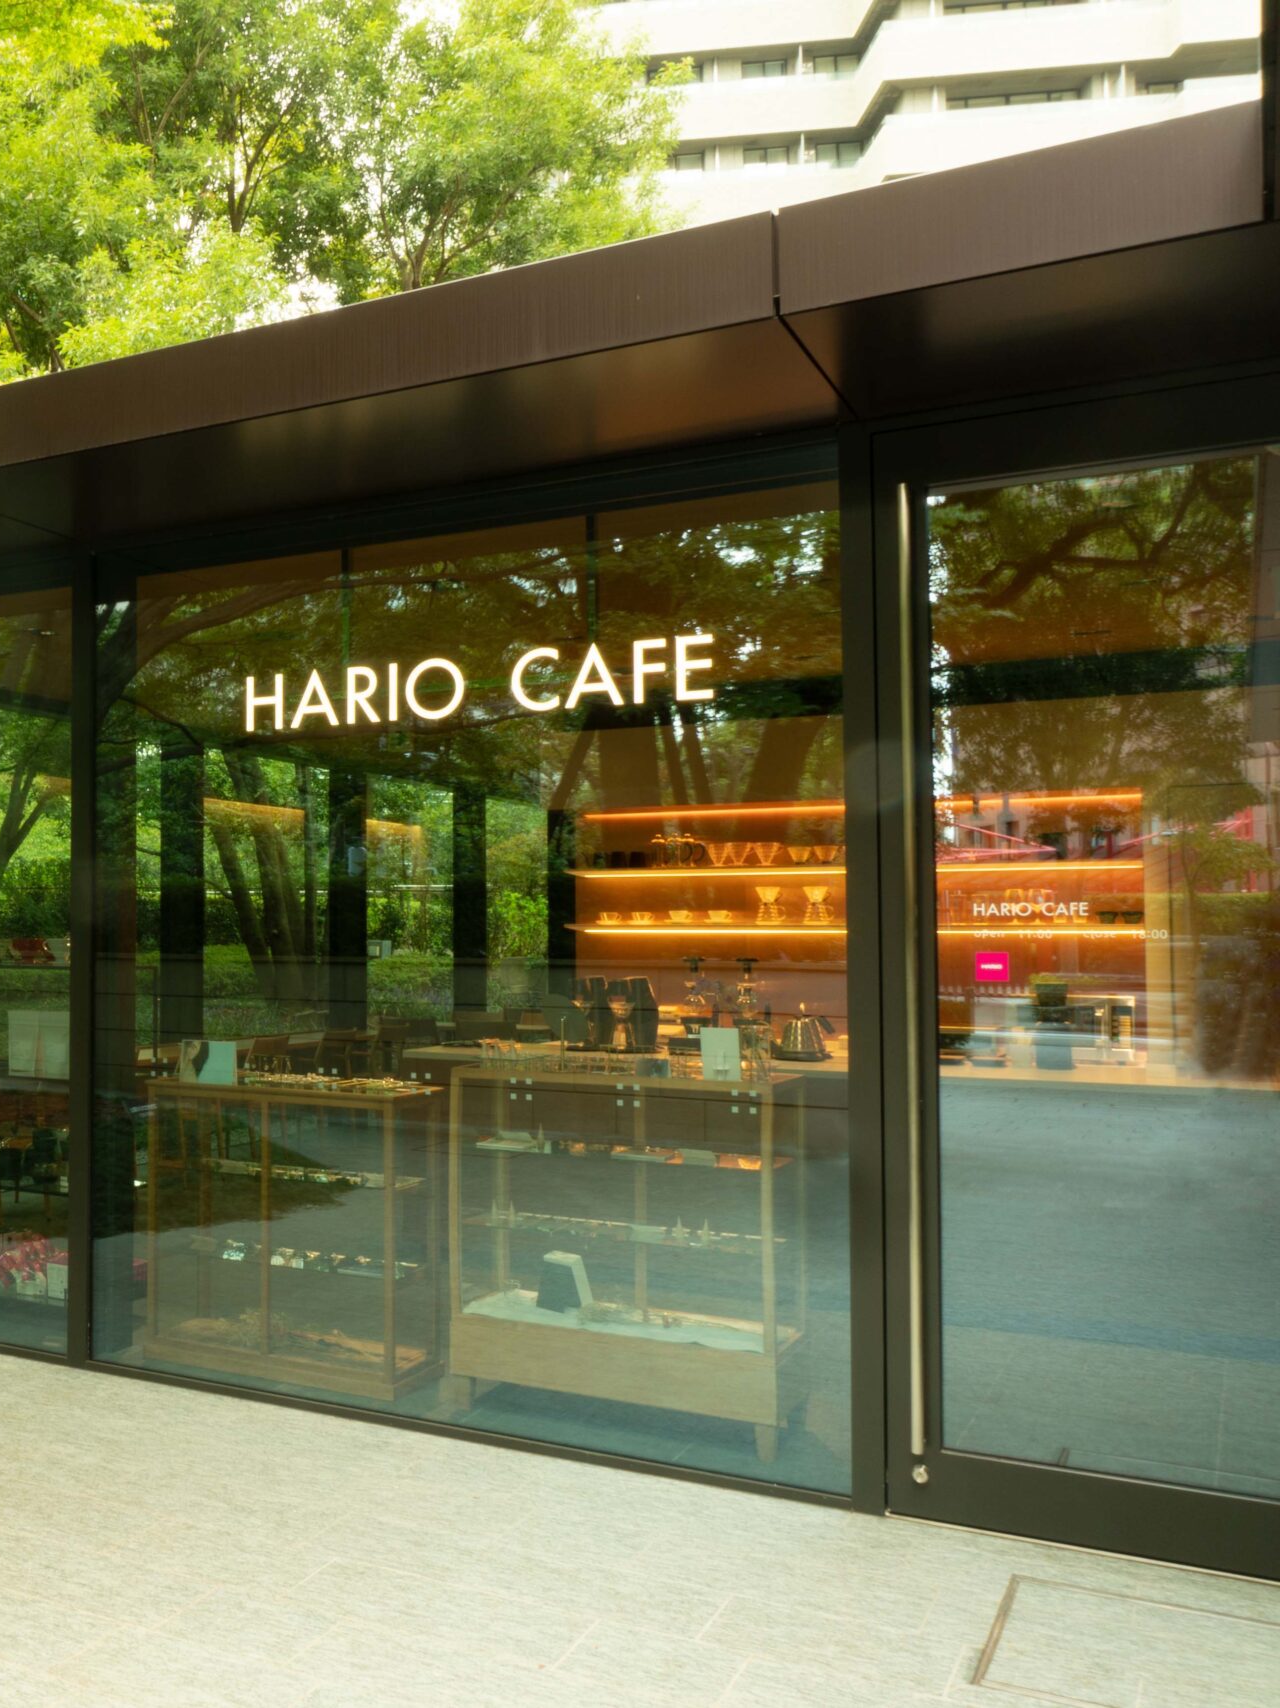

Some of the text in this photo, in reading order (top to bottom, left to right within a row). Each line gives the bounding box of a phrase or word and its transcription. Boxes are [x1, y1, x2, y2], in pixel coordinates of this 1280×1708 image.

[245, 633, 715, 732] HARIO CAFE
[973, 902, 1089, 917] HARIO CAFE
